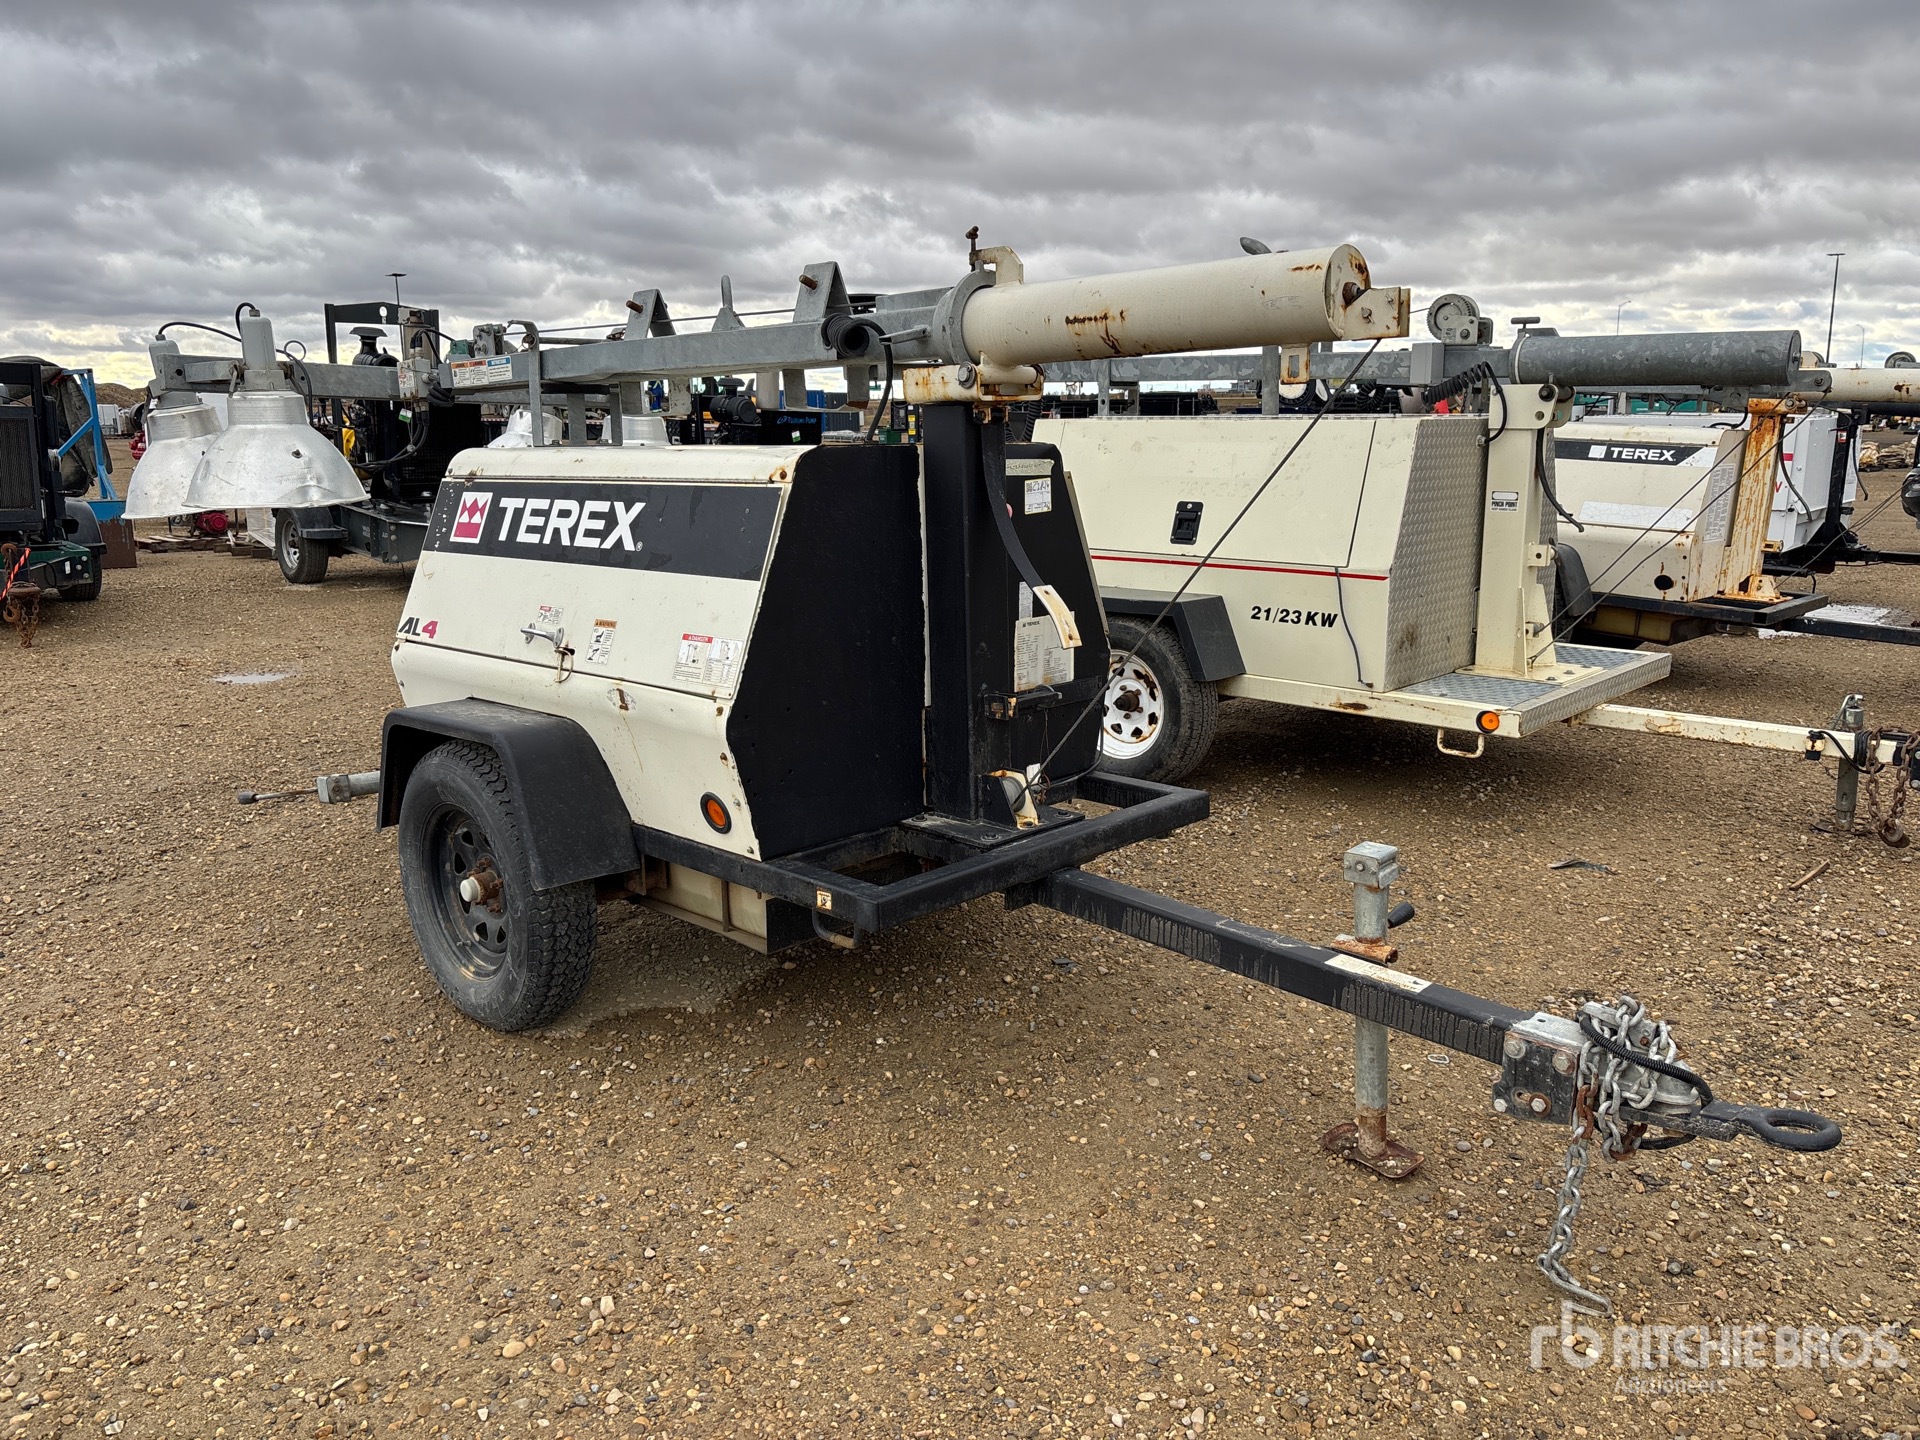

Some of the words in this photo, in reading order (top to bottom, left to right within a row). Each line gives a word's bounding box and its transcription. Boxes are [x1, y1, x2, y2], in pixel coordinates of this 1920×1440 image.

[1610, 447, 1676, 461] TEREX
[498, 497, 646, 551] TEREX
[398, 617, 439, 639] AL4
[1250, 606, 1302, 624] 21/23
[1304, 611, 1338, 628] KW
